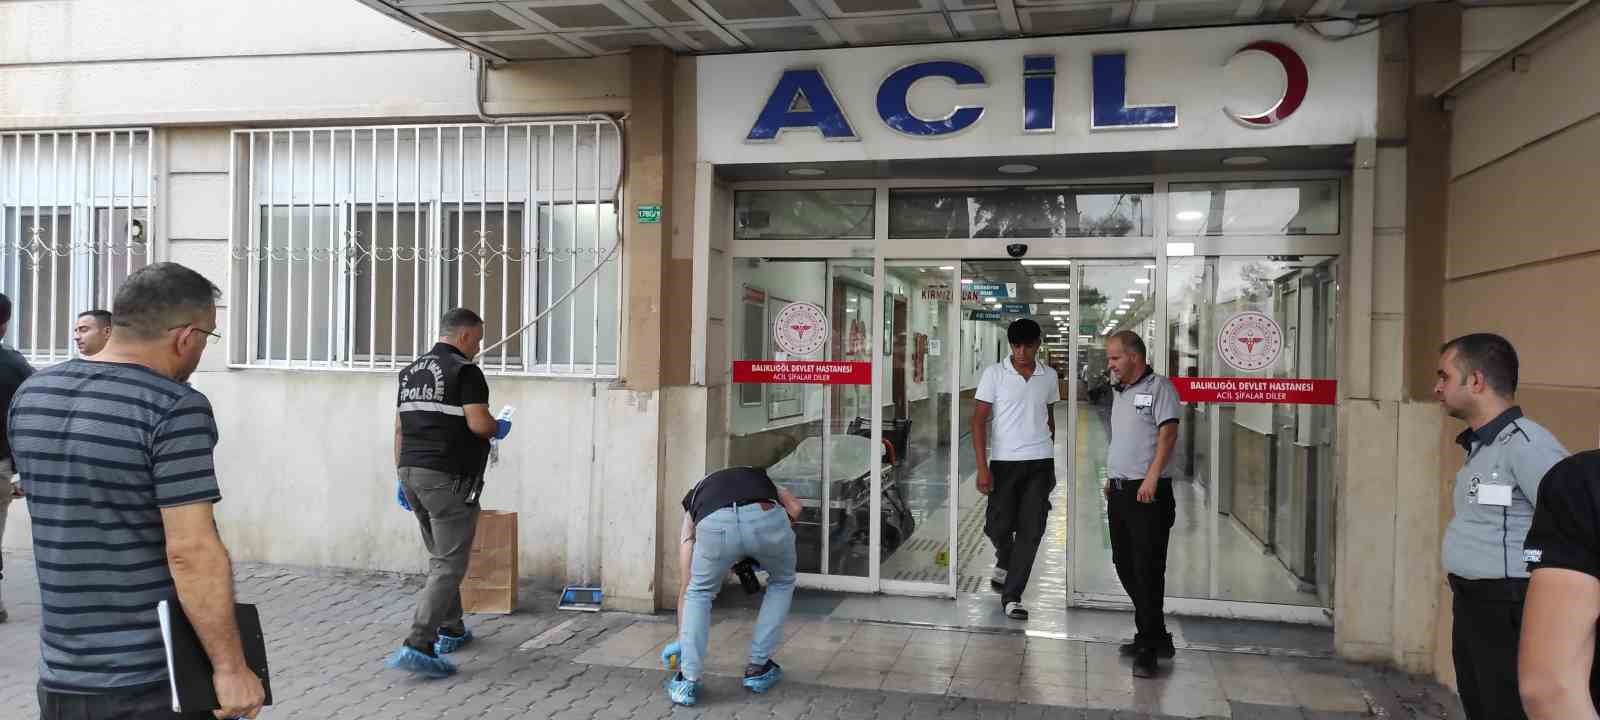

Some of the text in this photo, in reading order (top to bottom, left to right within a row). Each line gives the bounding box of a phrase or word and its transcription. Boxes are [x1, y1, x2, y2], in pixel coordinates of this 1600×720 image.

[744, 53, 1178, 143] ACİL
[961, 290, 978, 301] LAN
[751, 363, 853, 374] BALIKLIGÖL DEVLET HASTANESİ
[788, 373, 812, 382] ŞİFALAR
[1190, 381, 1314, 392] BALIKLIGÖL DEVLET HASTANESİ
[403, 384, 434, 401] POLİS
[1234, 391, 1264, 401] ŞİFALAR
[1265, 392, 1287, 401] DİLER
